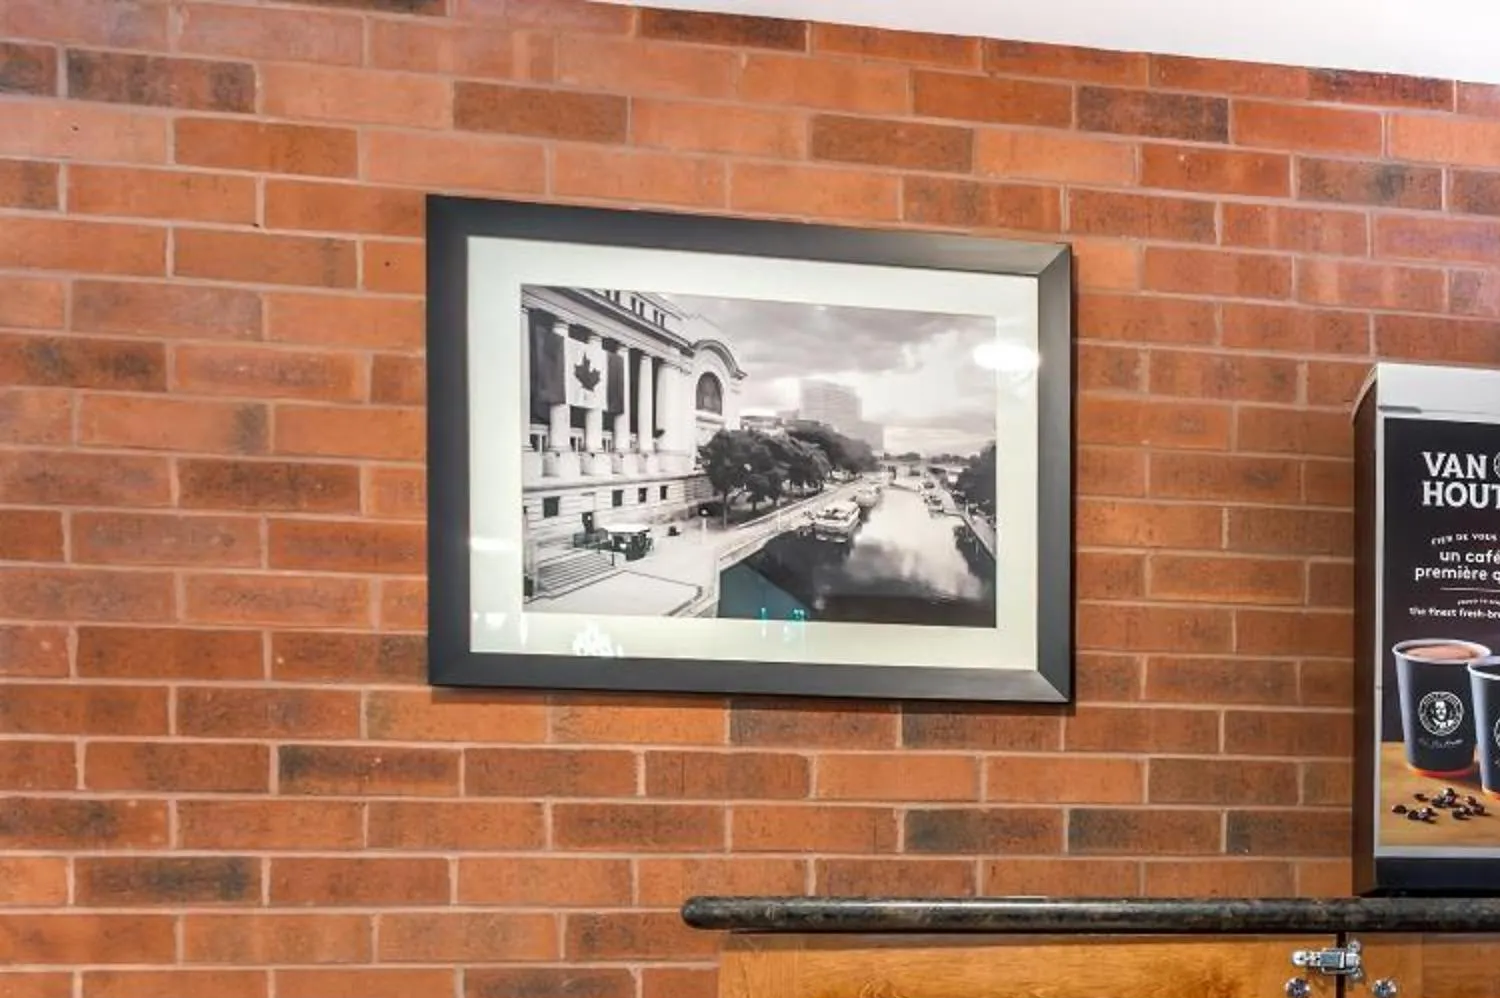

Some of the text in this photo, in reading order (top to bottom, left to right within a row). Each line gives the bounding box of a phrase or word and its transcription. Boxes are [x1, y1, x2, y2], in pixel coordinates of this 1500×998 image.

[1422, 451, 1487, 479] VAN
[1455, 533, 1468, 541] DE
[1439, 551, 1461, 562] un
[1415, 565, 1488, 581] première
[1409, 607, 1426, 615] the
[1428, 607, 1457, 617] finest
